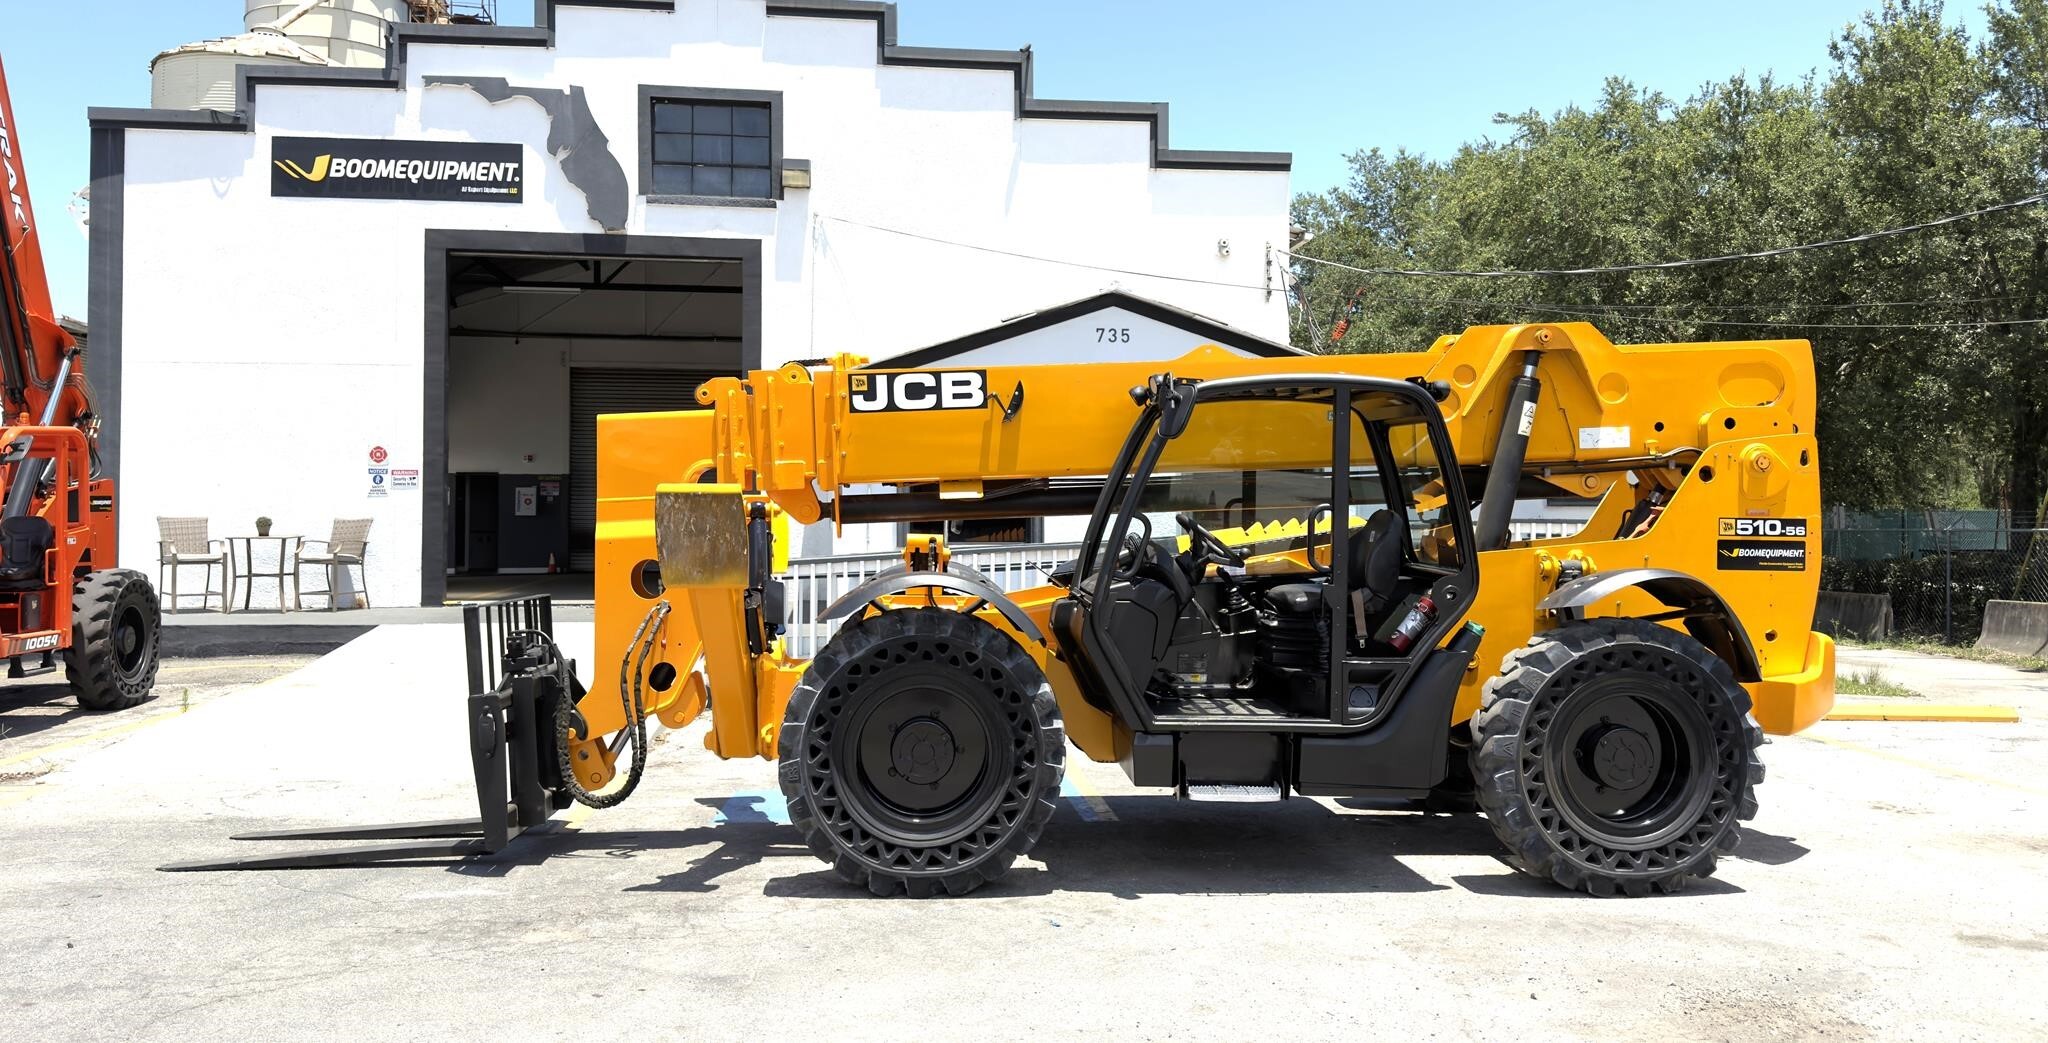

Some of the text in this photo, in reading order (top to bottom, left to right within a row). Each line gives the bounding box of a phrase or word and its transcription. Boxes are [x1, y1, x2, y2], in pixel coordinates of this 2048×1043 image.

[1096, 328, 1130, 343] 735
[852, 372, 985, 411] JCB
[1736, 519, 1806, 536] 510-56
[26, 634, 58, 650] 10054
